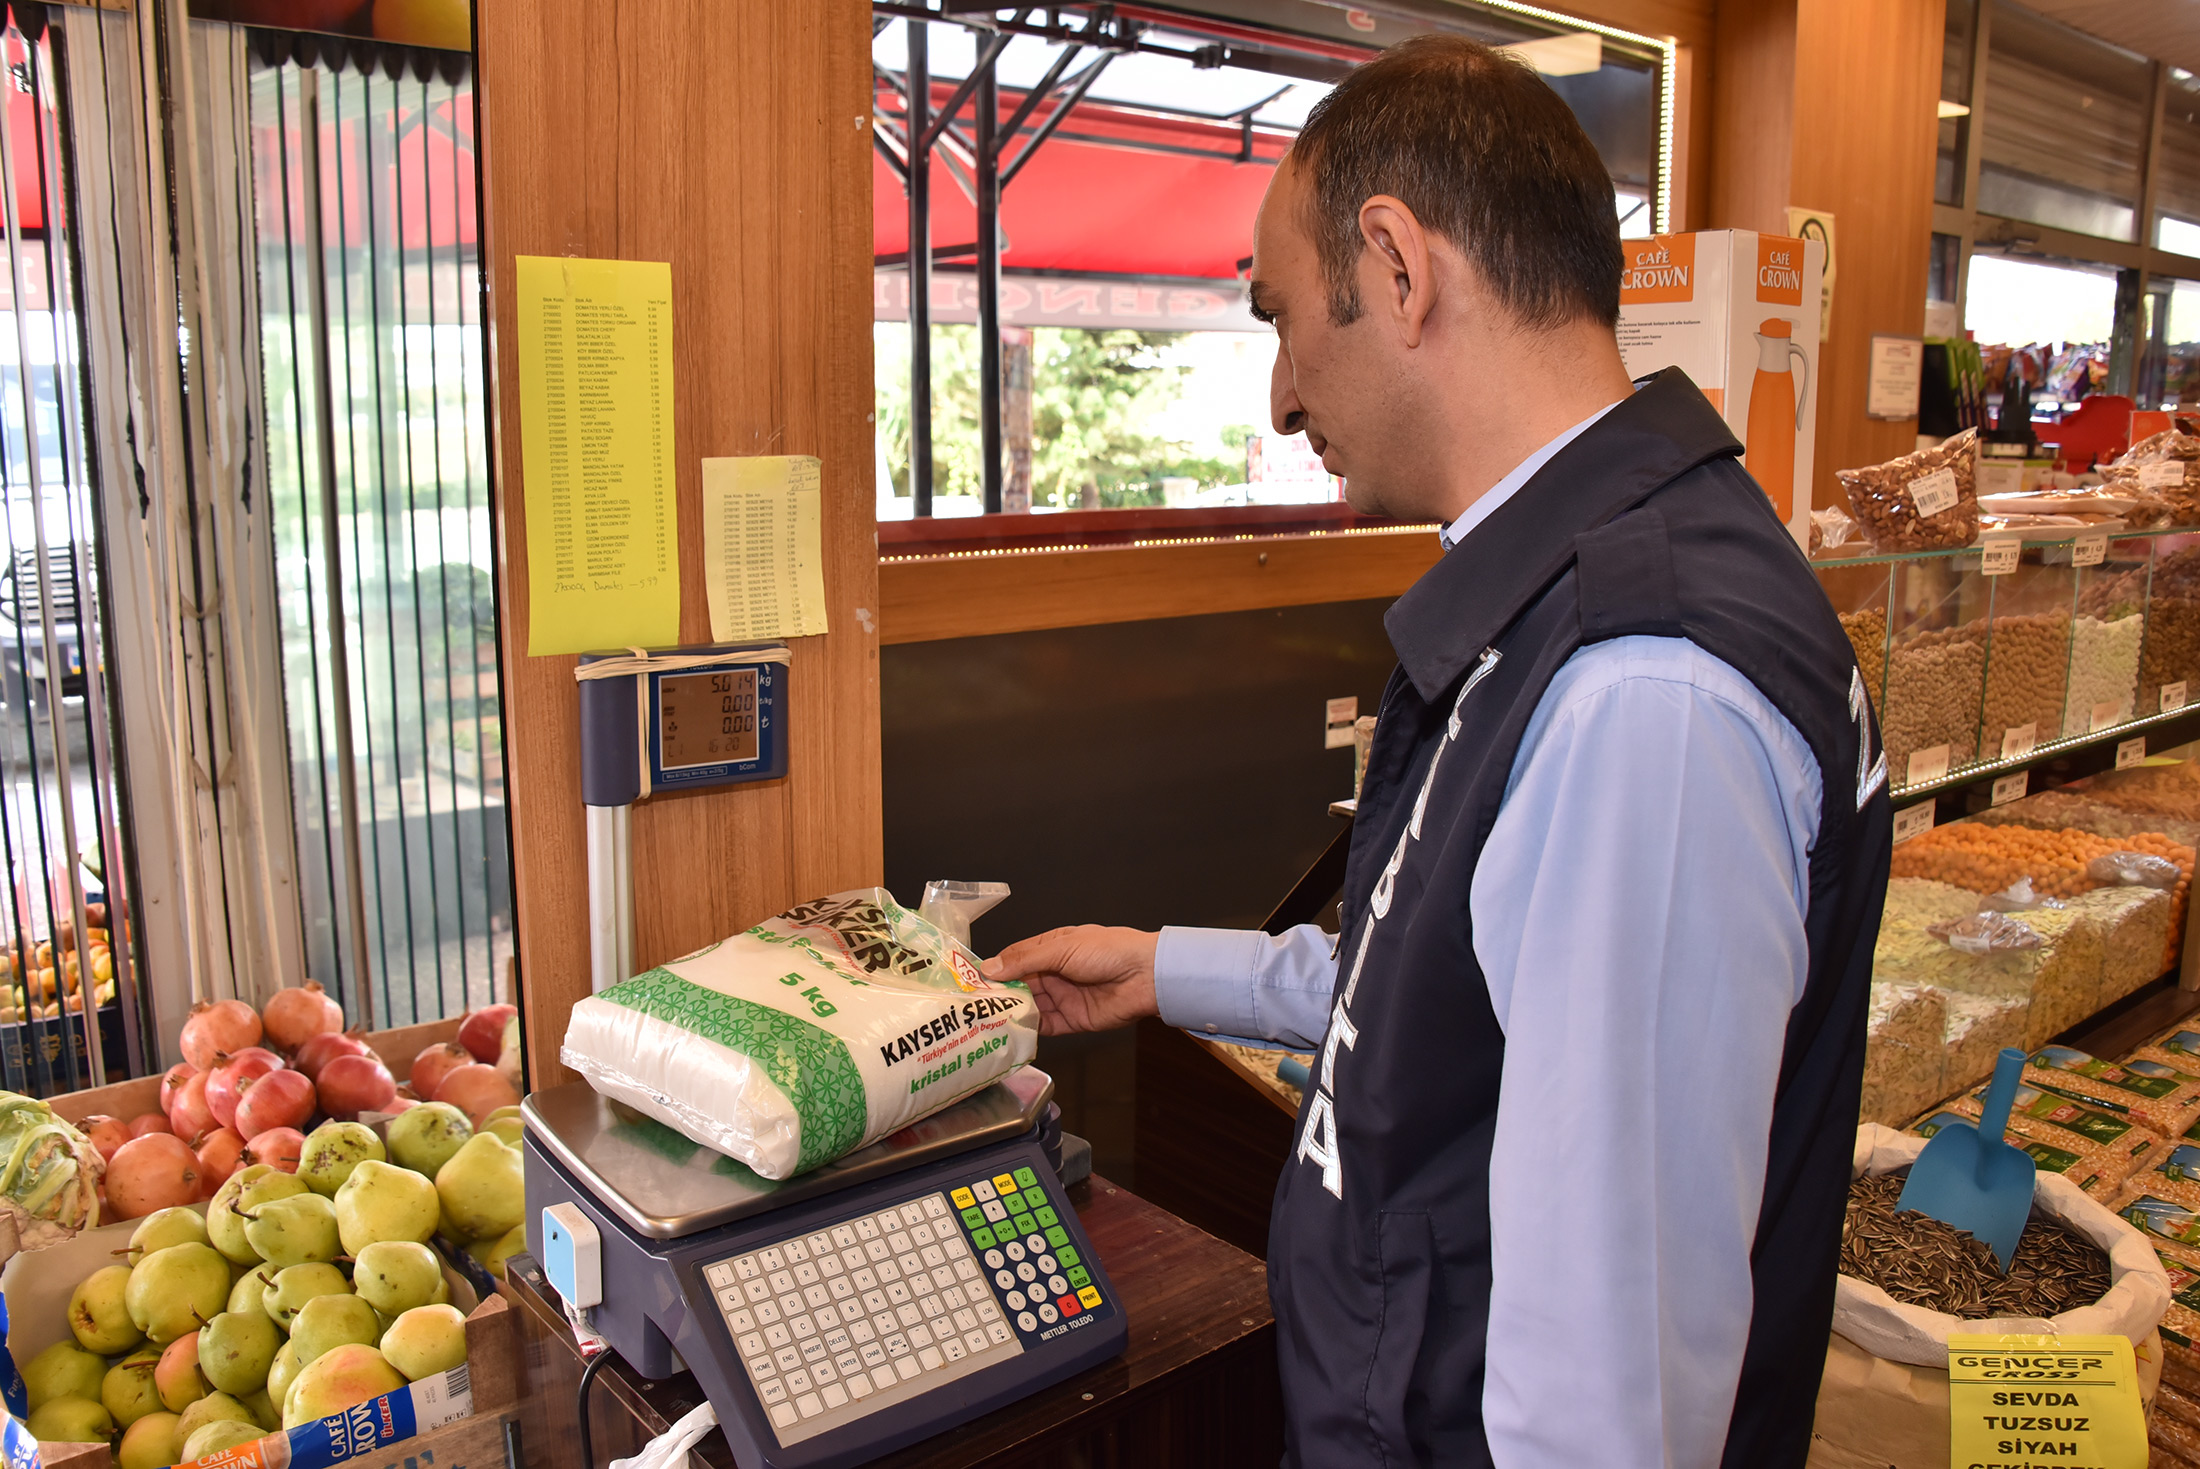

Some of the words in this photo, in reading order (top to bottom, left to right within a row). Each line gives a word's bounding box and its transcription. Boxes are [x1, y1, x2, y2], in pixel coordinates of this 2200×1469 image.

[1636, 249, 1670, 266] CAFÉ
[1769, 251, 1790, 266] CAFÉ
[1621, 265, 1690, 290] CROWN
[1759, 265, 1801, 291] CROWN
[759, 674, 772, 687] kg
[779, 972, 806, 987] 5
[800, 986, 838, 1018] kg
[880, 1005, 960, 1067] KAYSERİ
[959, 1034, 968, 1044] en
[910, 1055, 962, 1094] kristal
[966, 1034, 1009, 1068] şeker
[955, 1193, 970, 1202] CODE
[997, 1180, 1012, 1188] MODE
[966, 1213, 980, 1222] TARE
[1021, 1219, 1031, 1228] FIX
[1012, 1247, 1019, 1255] 8
[1073, 1277, 1088, 1286] ENTER
[1034, 1288, 1040, 1296] 2
[1082, 1292, 1096, 1303] PRINT
[1040, 1325, 1069, 1341] METTLER
[1068, 1314, 1094, 1331] TOLEDO
[754, 1362, 772, 1372] HOME
[782, 1354, 794, 1363] END
[804, 1343, 822, 1355] INSERT
[828, 1334, 848, 1346] DELETE
[982, 1306, 993, 1315] LOG
[765, 1386, 781, 1396] SHIFT
[794, 1377, 803, 1385] ALT
[820, 1368, 828, 1376] BS
[840, 1358, 857, 1369] ENTER
[865, 1349, 881, 1359] CHAR
[890, 1338, 903, 1347] abc
[1957, 1356, 2104, 1371] GENÇER
[1981, 1370, 2081, 1379] GROSS
[1992, 1392, 2080, 1407] SEVDA
[377, 1395, 395, 1438] ÜLKER
[1983, 1416, 2090, 1432] TUZSUZ
[323, 1414, 347, 1458] CAFÉ
[1997, 1438, 2078, 1456] SİYAH
